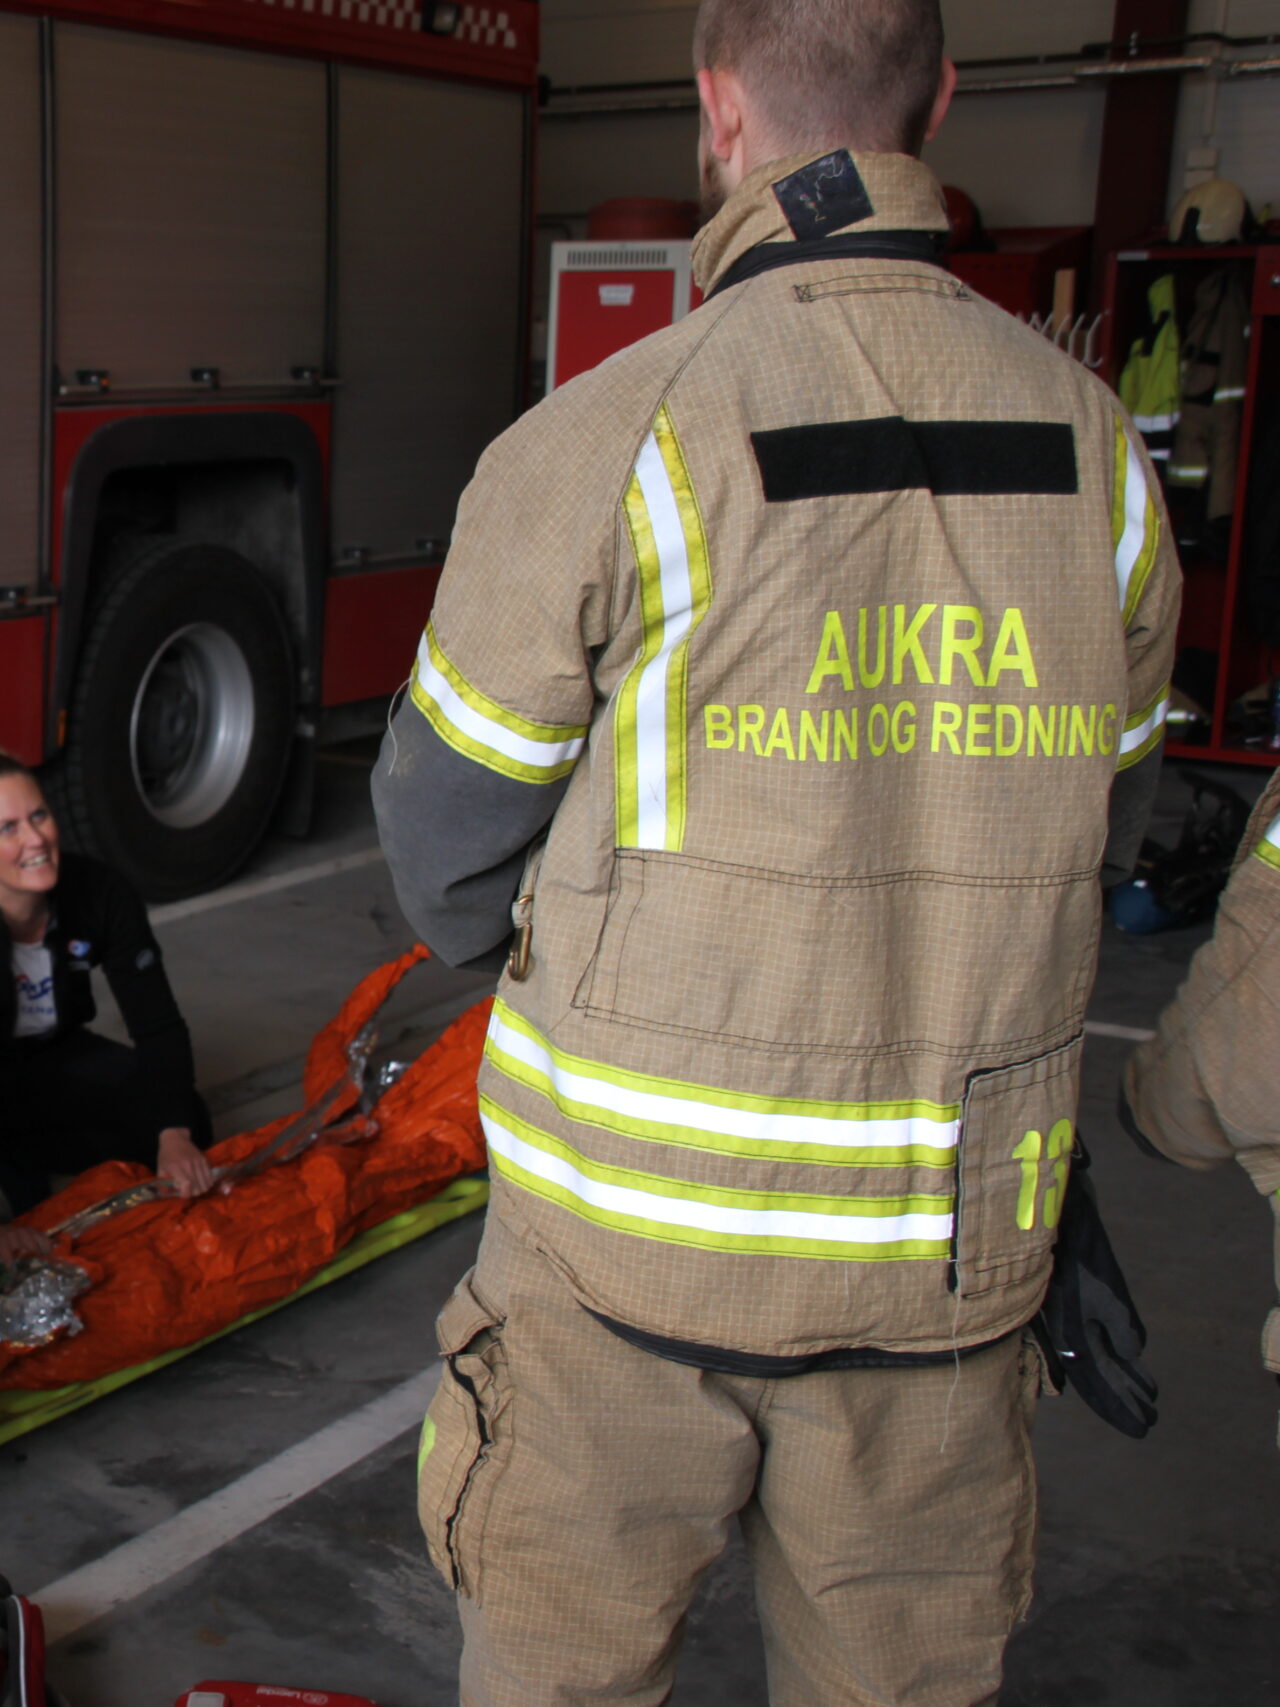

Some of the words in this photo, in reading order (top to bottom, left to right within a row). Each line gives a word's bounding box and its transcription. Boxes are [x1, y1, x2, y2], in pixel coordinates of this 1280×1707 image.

[805, 603, 1038, 693] AUKRA
[704, 704, 859, 762] BRANN
[867, 701, 916, 756] OG
[930, 701, 1116, 757] REDNING
